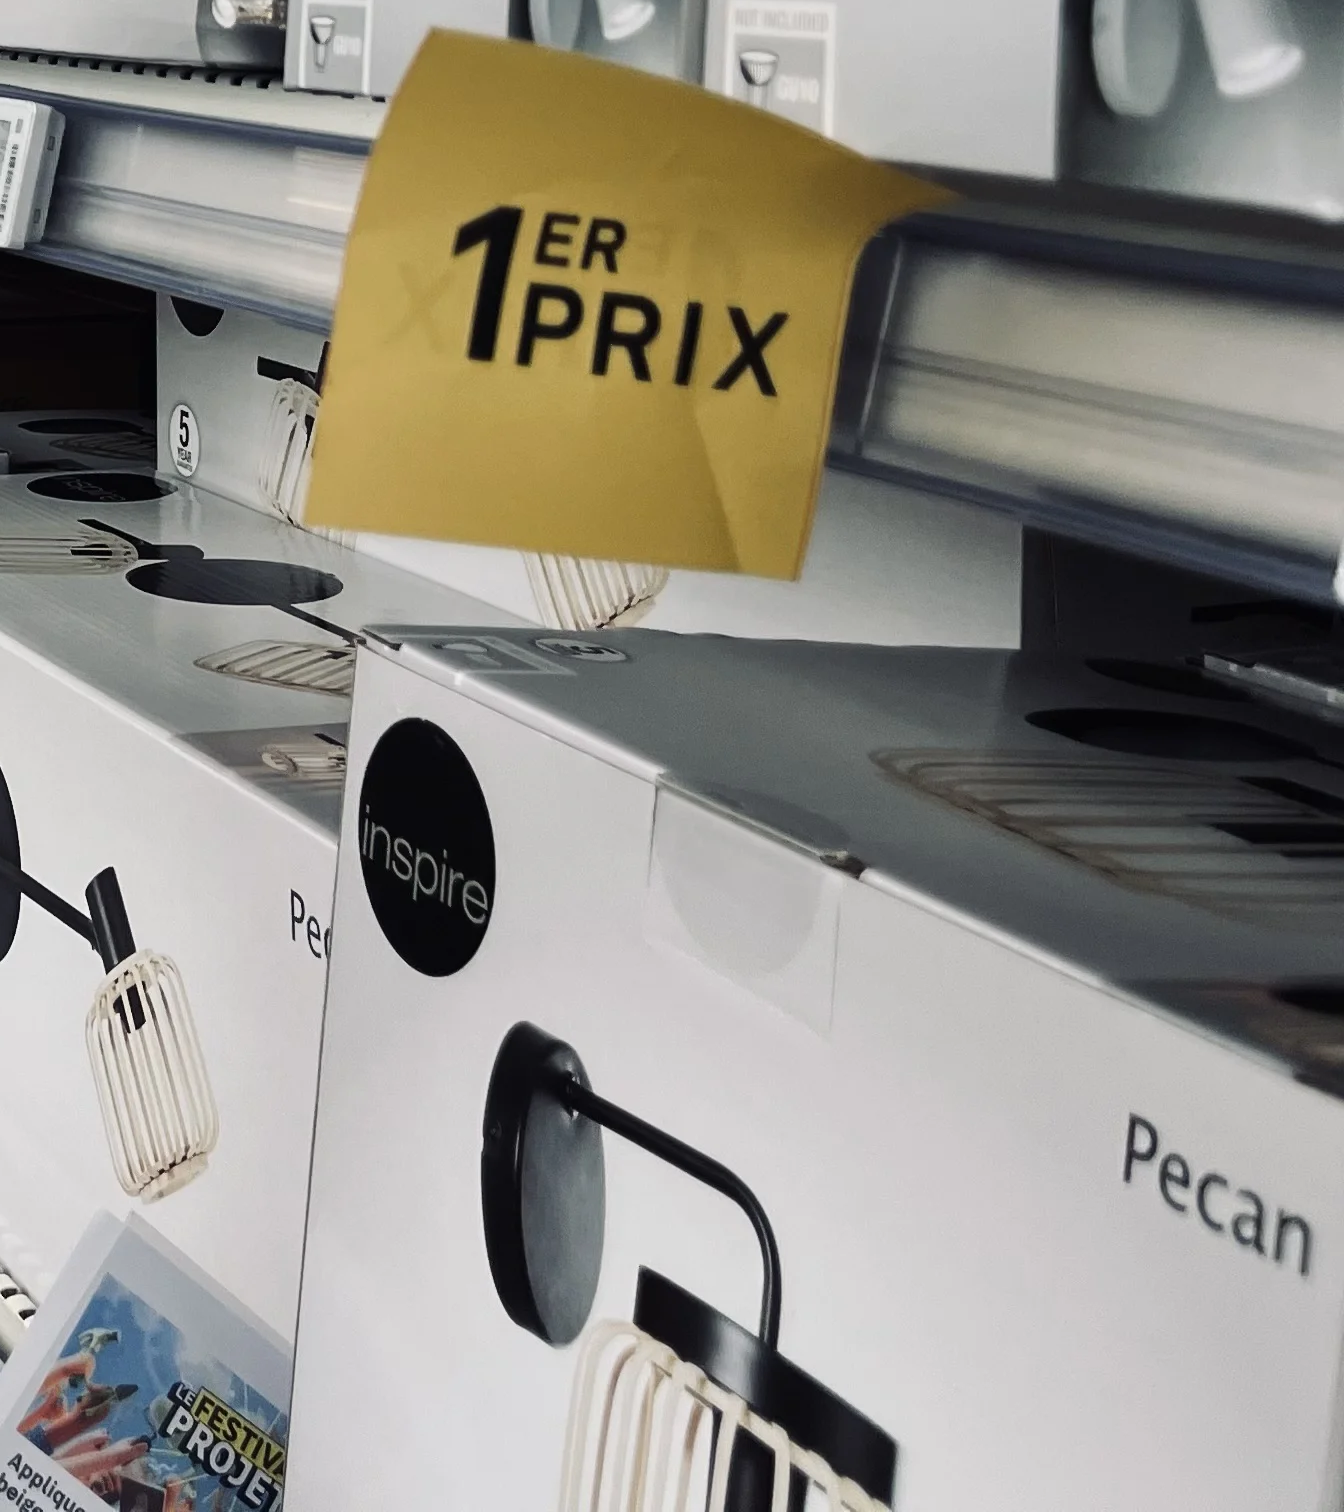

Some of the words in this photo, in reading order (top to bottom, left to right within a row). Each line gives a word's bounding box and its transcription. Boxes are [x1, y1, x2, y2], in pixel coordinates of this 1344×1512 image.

[515, 284, 790, 399] PRIX
[179, 409, 190, 448] 5
[359, 801, 490, 928] inspire
[290, 888, 332, 961] Pec
[1121, 1112, 1315, 1281] Pecan
[166, 1405, 283, 1508] PROJE
[175, 1383, 196, 1406] LE
[194, 1394, 286, 1478] FESTIV
